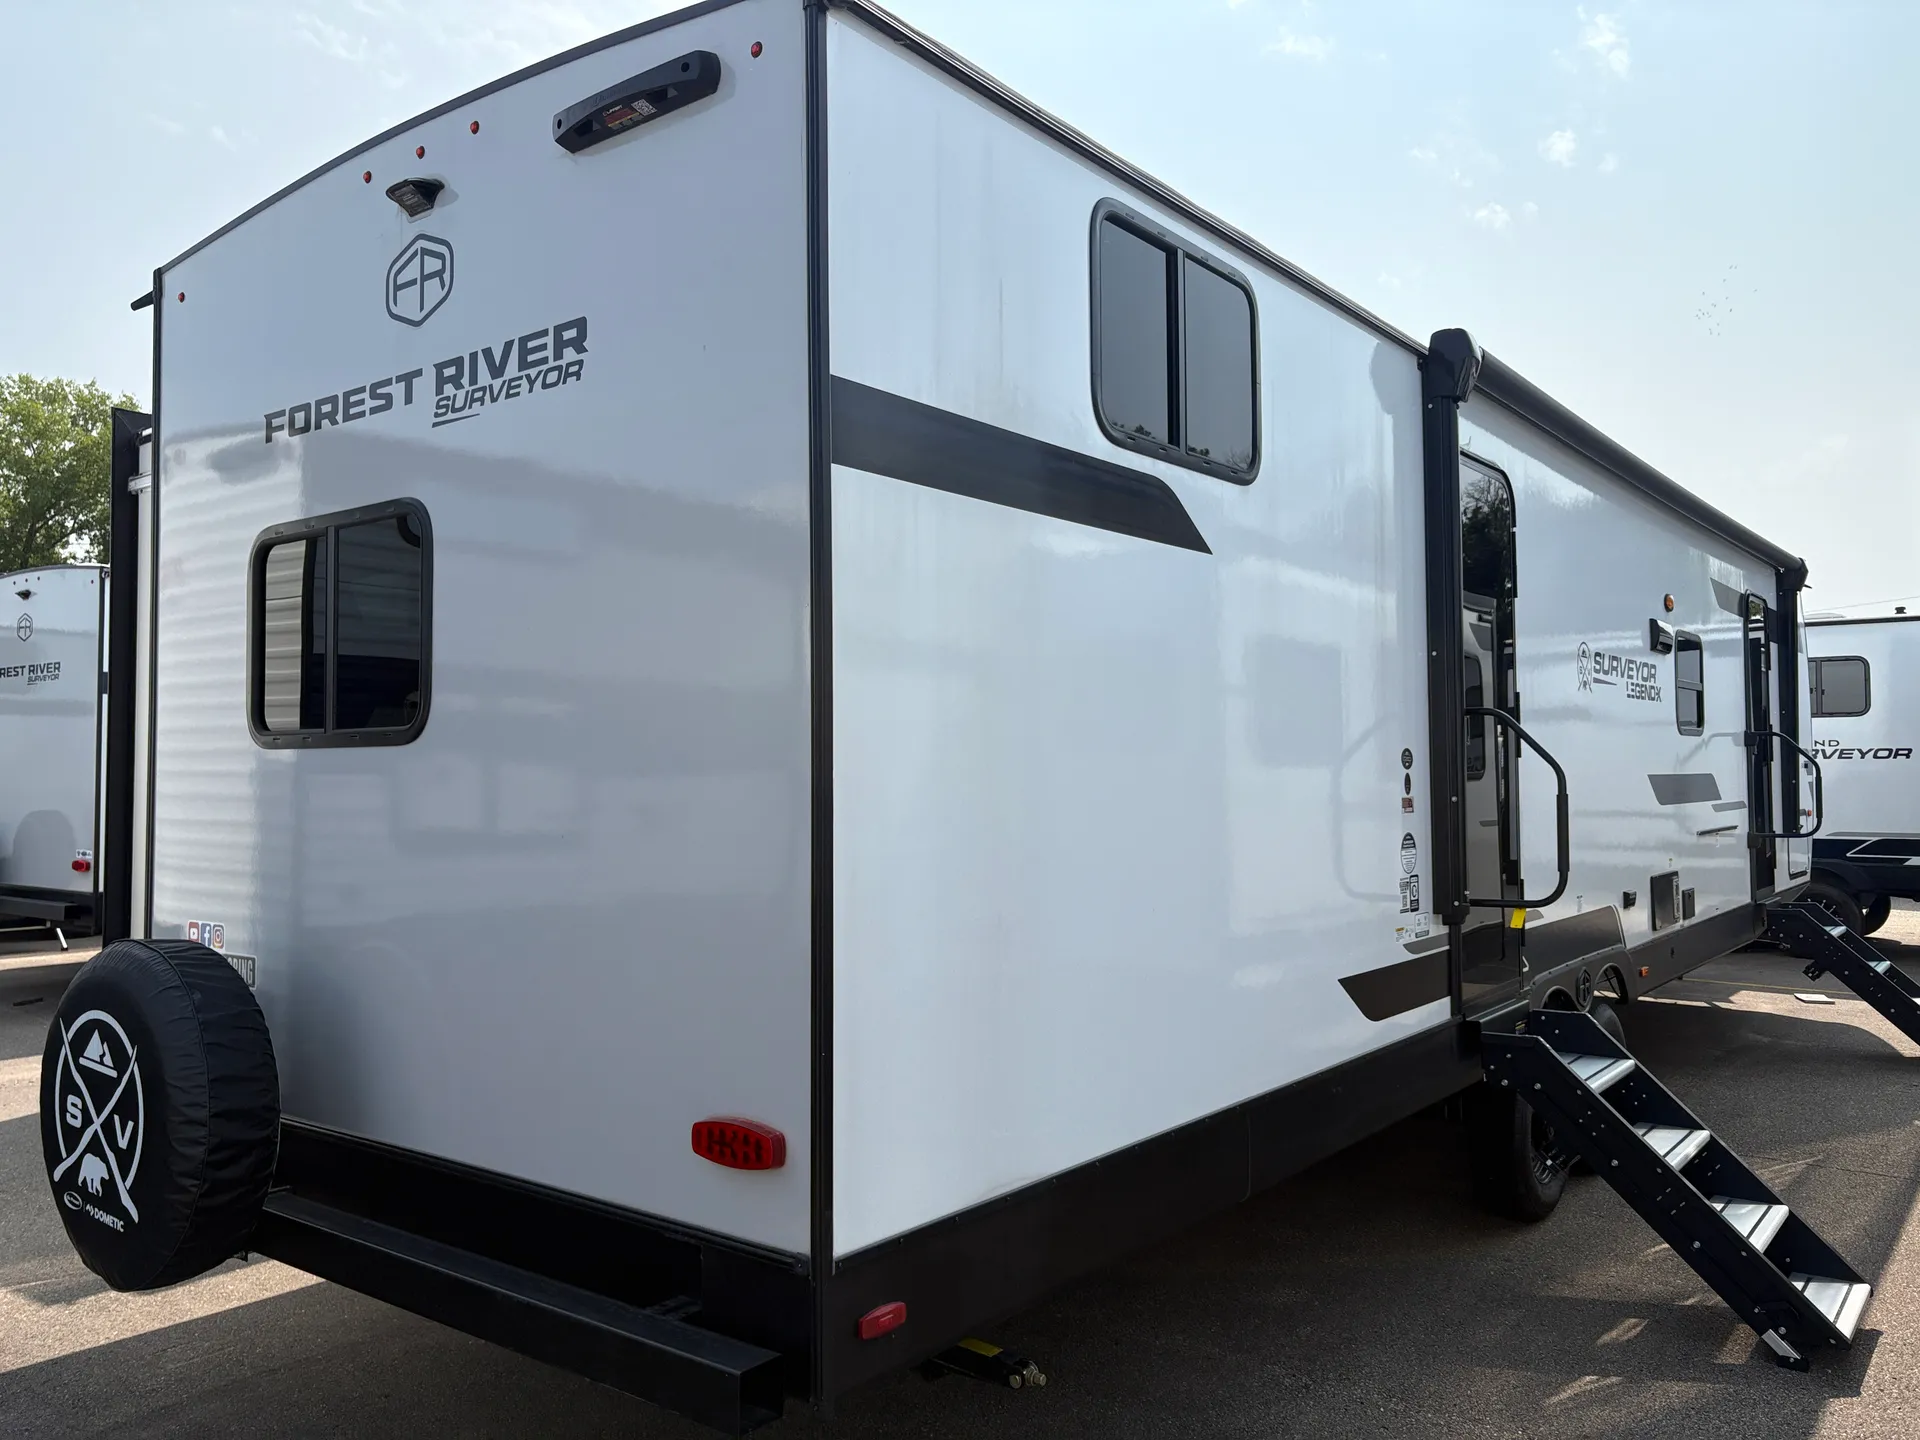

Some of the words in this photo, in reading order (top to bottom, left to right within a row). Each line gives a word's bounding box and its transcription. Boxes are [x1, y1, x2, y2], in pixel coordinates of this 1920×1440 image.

[264, 367, 424, 444] FOREST
[432, 315, 589, 397] RIVER
[432, 358, 585, 420] SURVEYOR
[27, 673, 59, 683] SURVEYOR
[28, 661, 60, 675] RIVER
[1593, 652, 1656, 683] SURVEYOR
[65, 1094, 83, 1129] S
[113, 1114, 134, 1150] V
[94, 1207, 125, 1233] DOMETIC
